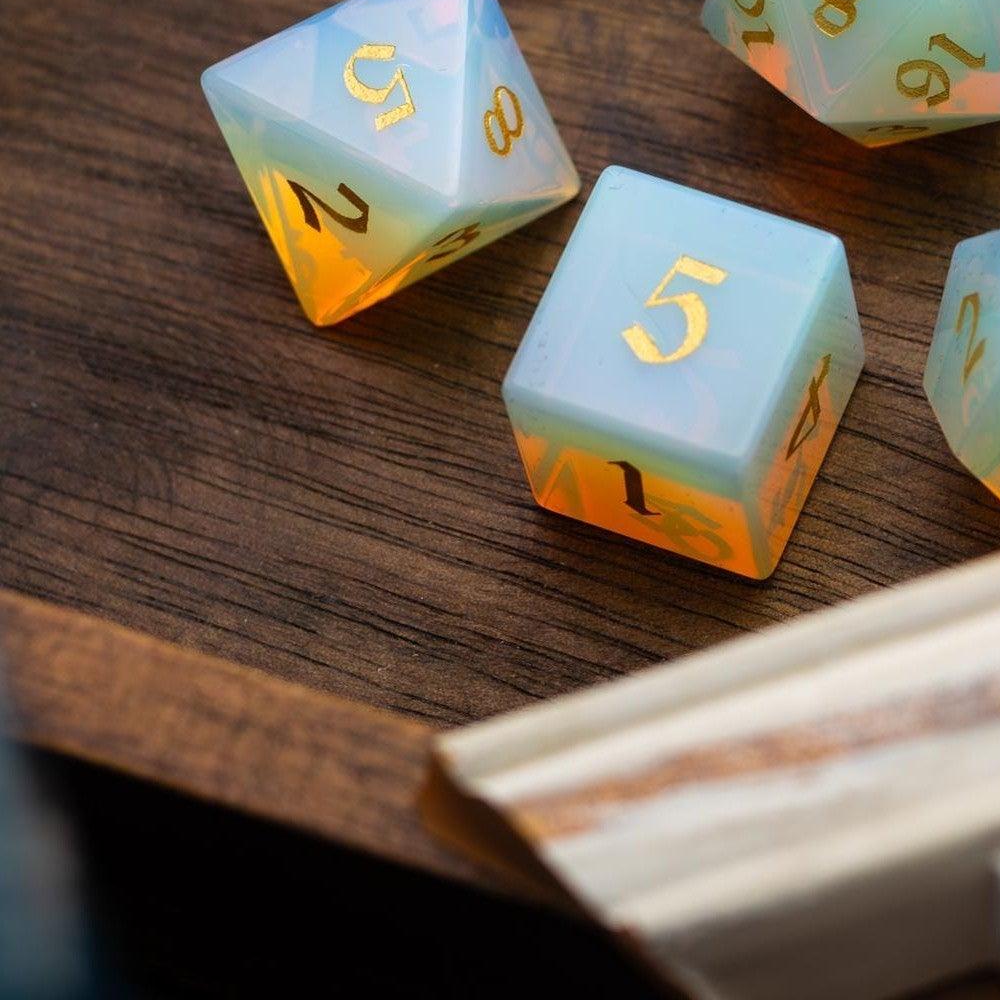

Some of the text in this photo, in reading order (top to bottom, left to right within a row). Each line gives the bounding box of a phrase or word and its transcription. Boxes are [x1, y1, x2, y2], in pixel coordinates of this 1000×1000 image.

[343, 44, 416, 132] 5
[484, 86, 525, 158] 8
[287, 179, 370, 234] 2
[621, 254, 728, 364] 5
[954, 292, 986, 386] 2
[606, 460, 662, 516] 1
